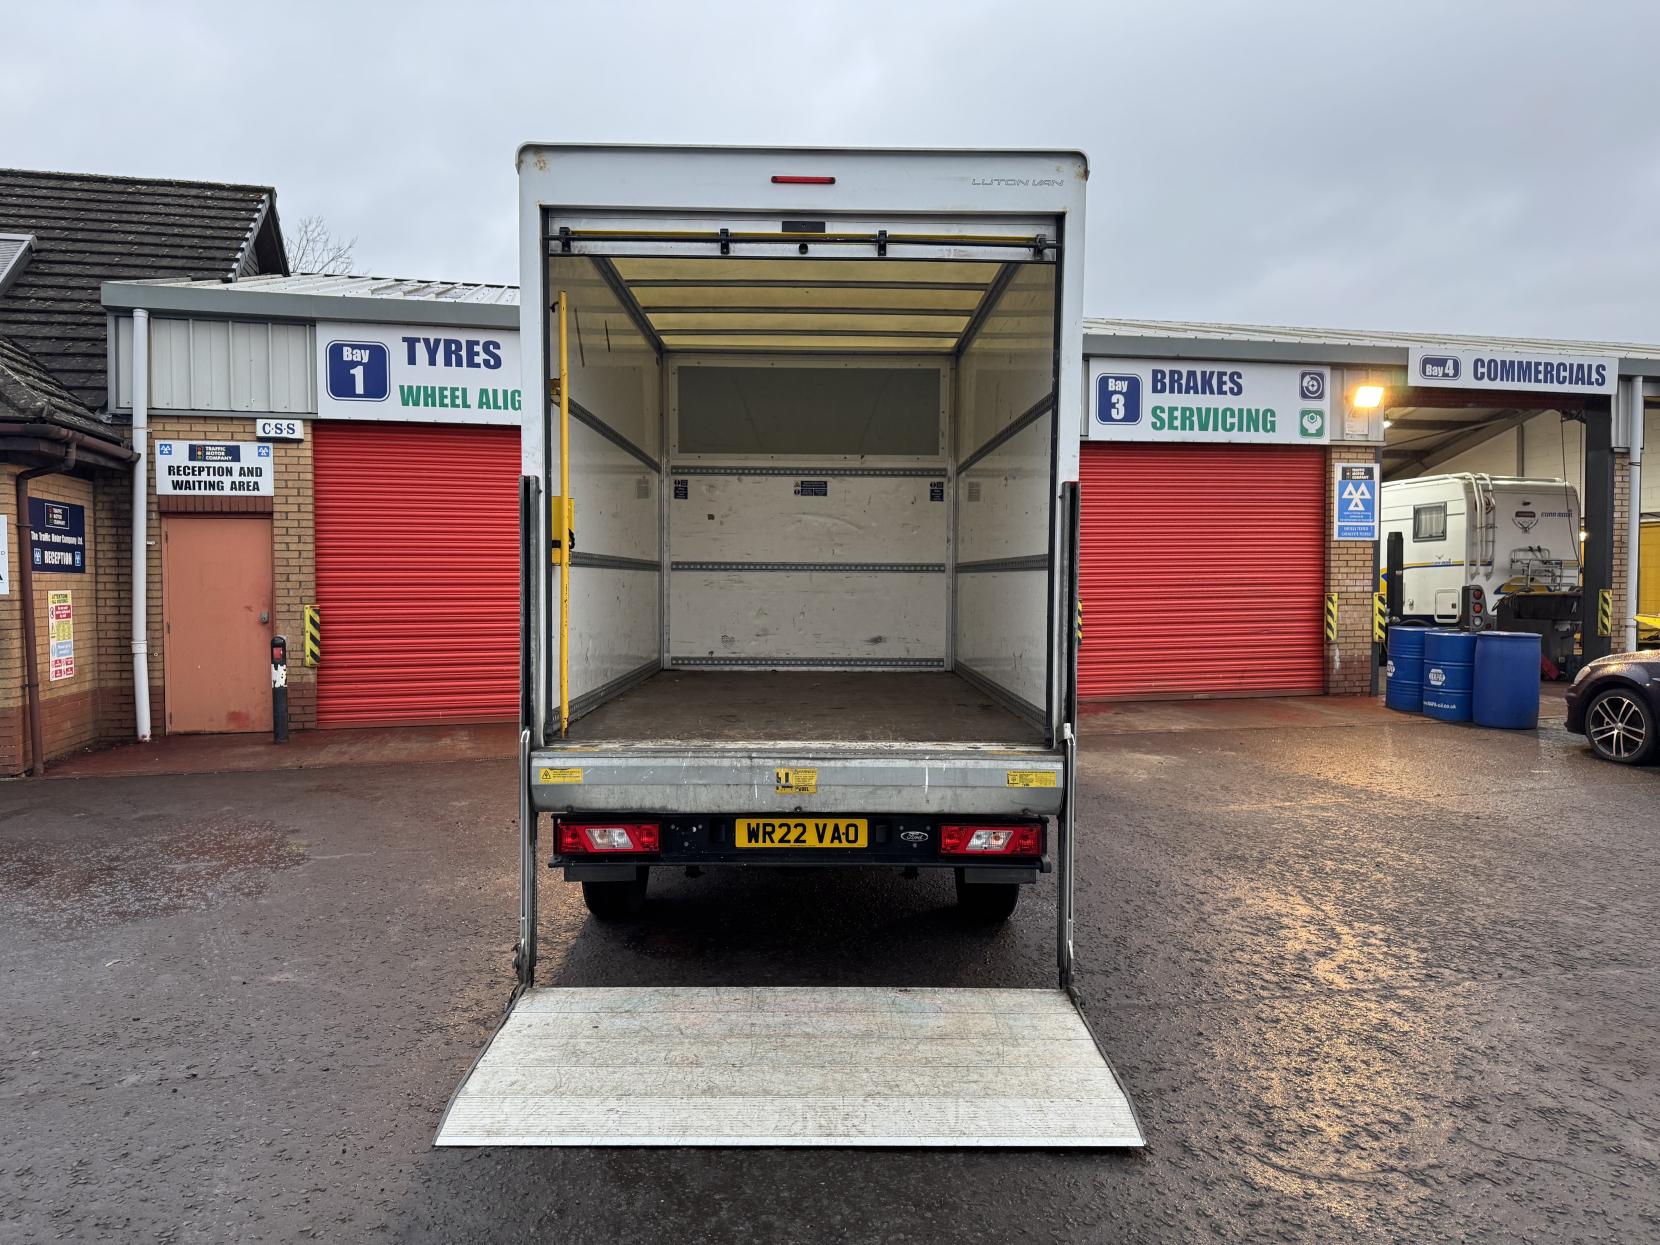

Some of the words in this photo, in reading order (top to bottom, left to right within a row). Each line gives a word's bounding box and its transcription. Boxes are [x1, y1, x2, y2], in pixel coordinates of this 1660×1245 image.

[972, 178, 1029, 187] LUTON
[1031, 179, 1064, 187] VAN
[343, 346, 370, 363] Bay
[401, 336, 502, 370] TYRES
[350, 365, 364, 395] 1
[1151, 368, 1243, 396] BRAKES
[1473, 357, 1606, 387] COMMERCIALS
[398, 384, 471, 409] WHEEL
[1108, 378, 1128, 393] Bay
[1111, 393, 1125, 420] 3
[1151, 405, 1277, 433] SERVICING
[167, 465, 233, 477] RECEPTION
[238, 466, 263, 478] AND
[171, 480, 225, 491] WAITING
[229, 480, 260, 492] AREA
[44, 550, 72, 566] RECEPTION
[746, 822, 807, 844] WR22
[814, 822, 859, 844] VAO
